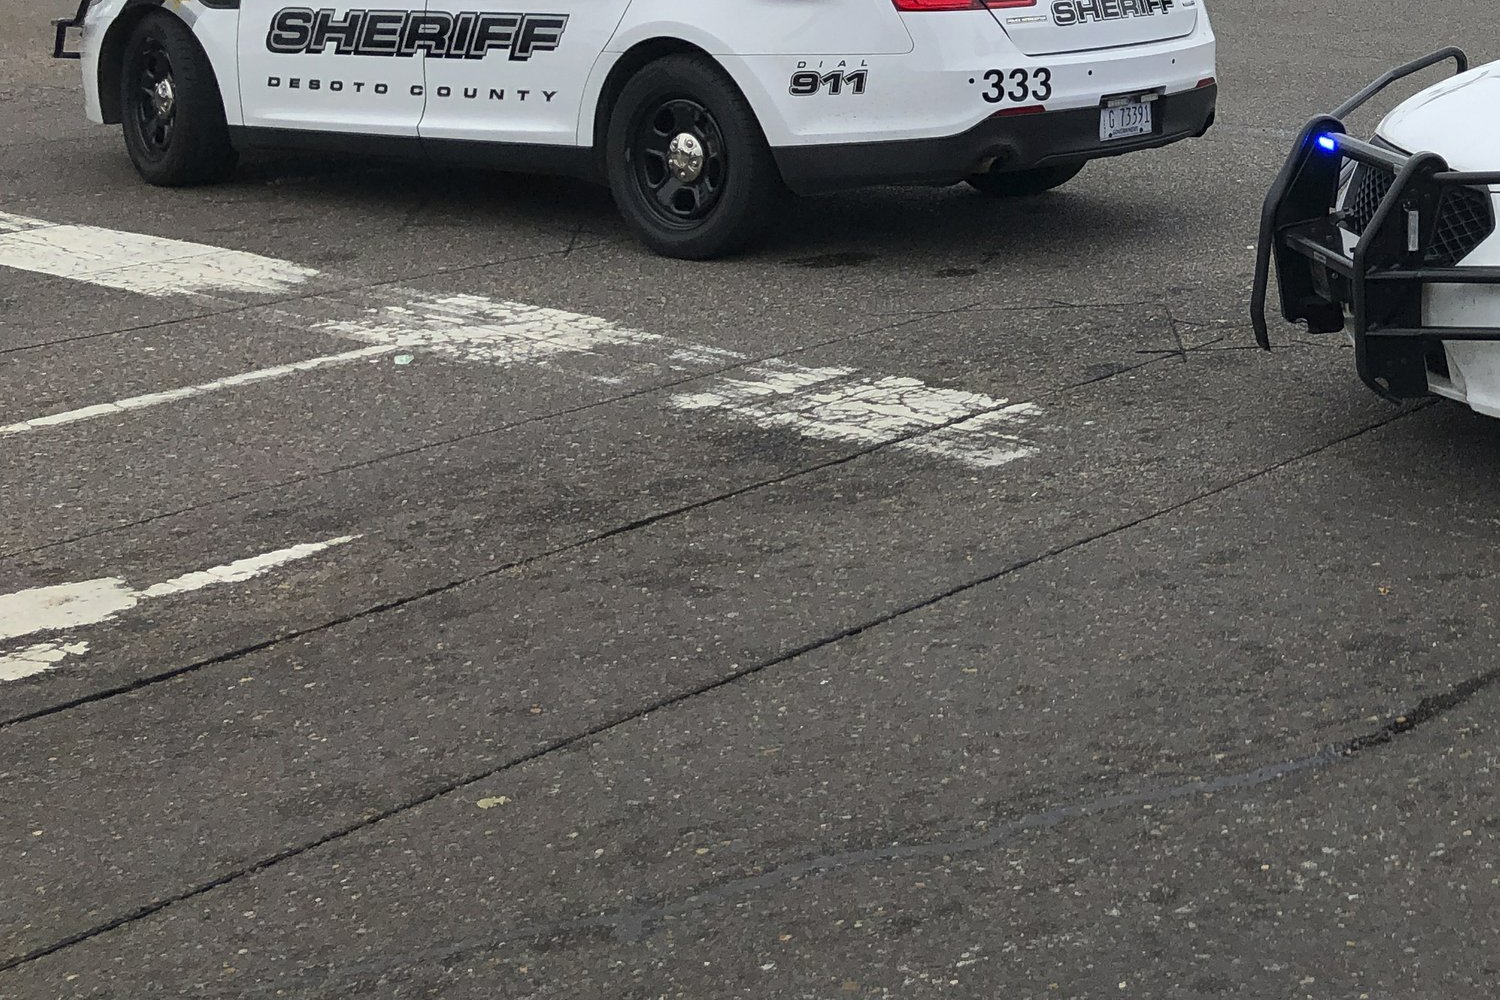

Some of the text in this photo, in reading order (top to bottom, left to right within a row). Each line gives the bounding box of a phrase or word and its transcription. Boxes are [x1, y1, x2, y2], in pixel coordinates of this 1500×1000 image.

[265, 6, 570, 62] SHERIFF
[796, 59, 869, 69] DIAL
[267, 76, 558, 102] DESOTO COUNTY
[788, 69, 869, 97] 911
[981, 67, 1053, 104] 333
[1108, 109, 1115, 129] G
[1119, 104, 1150, 127] 73391
